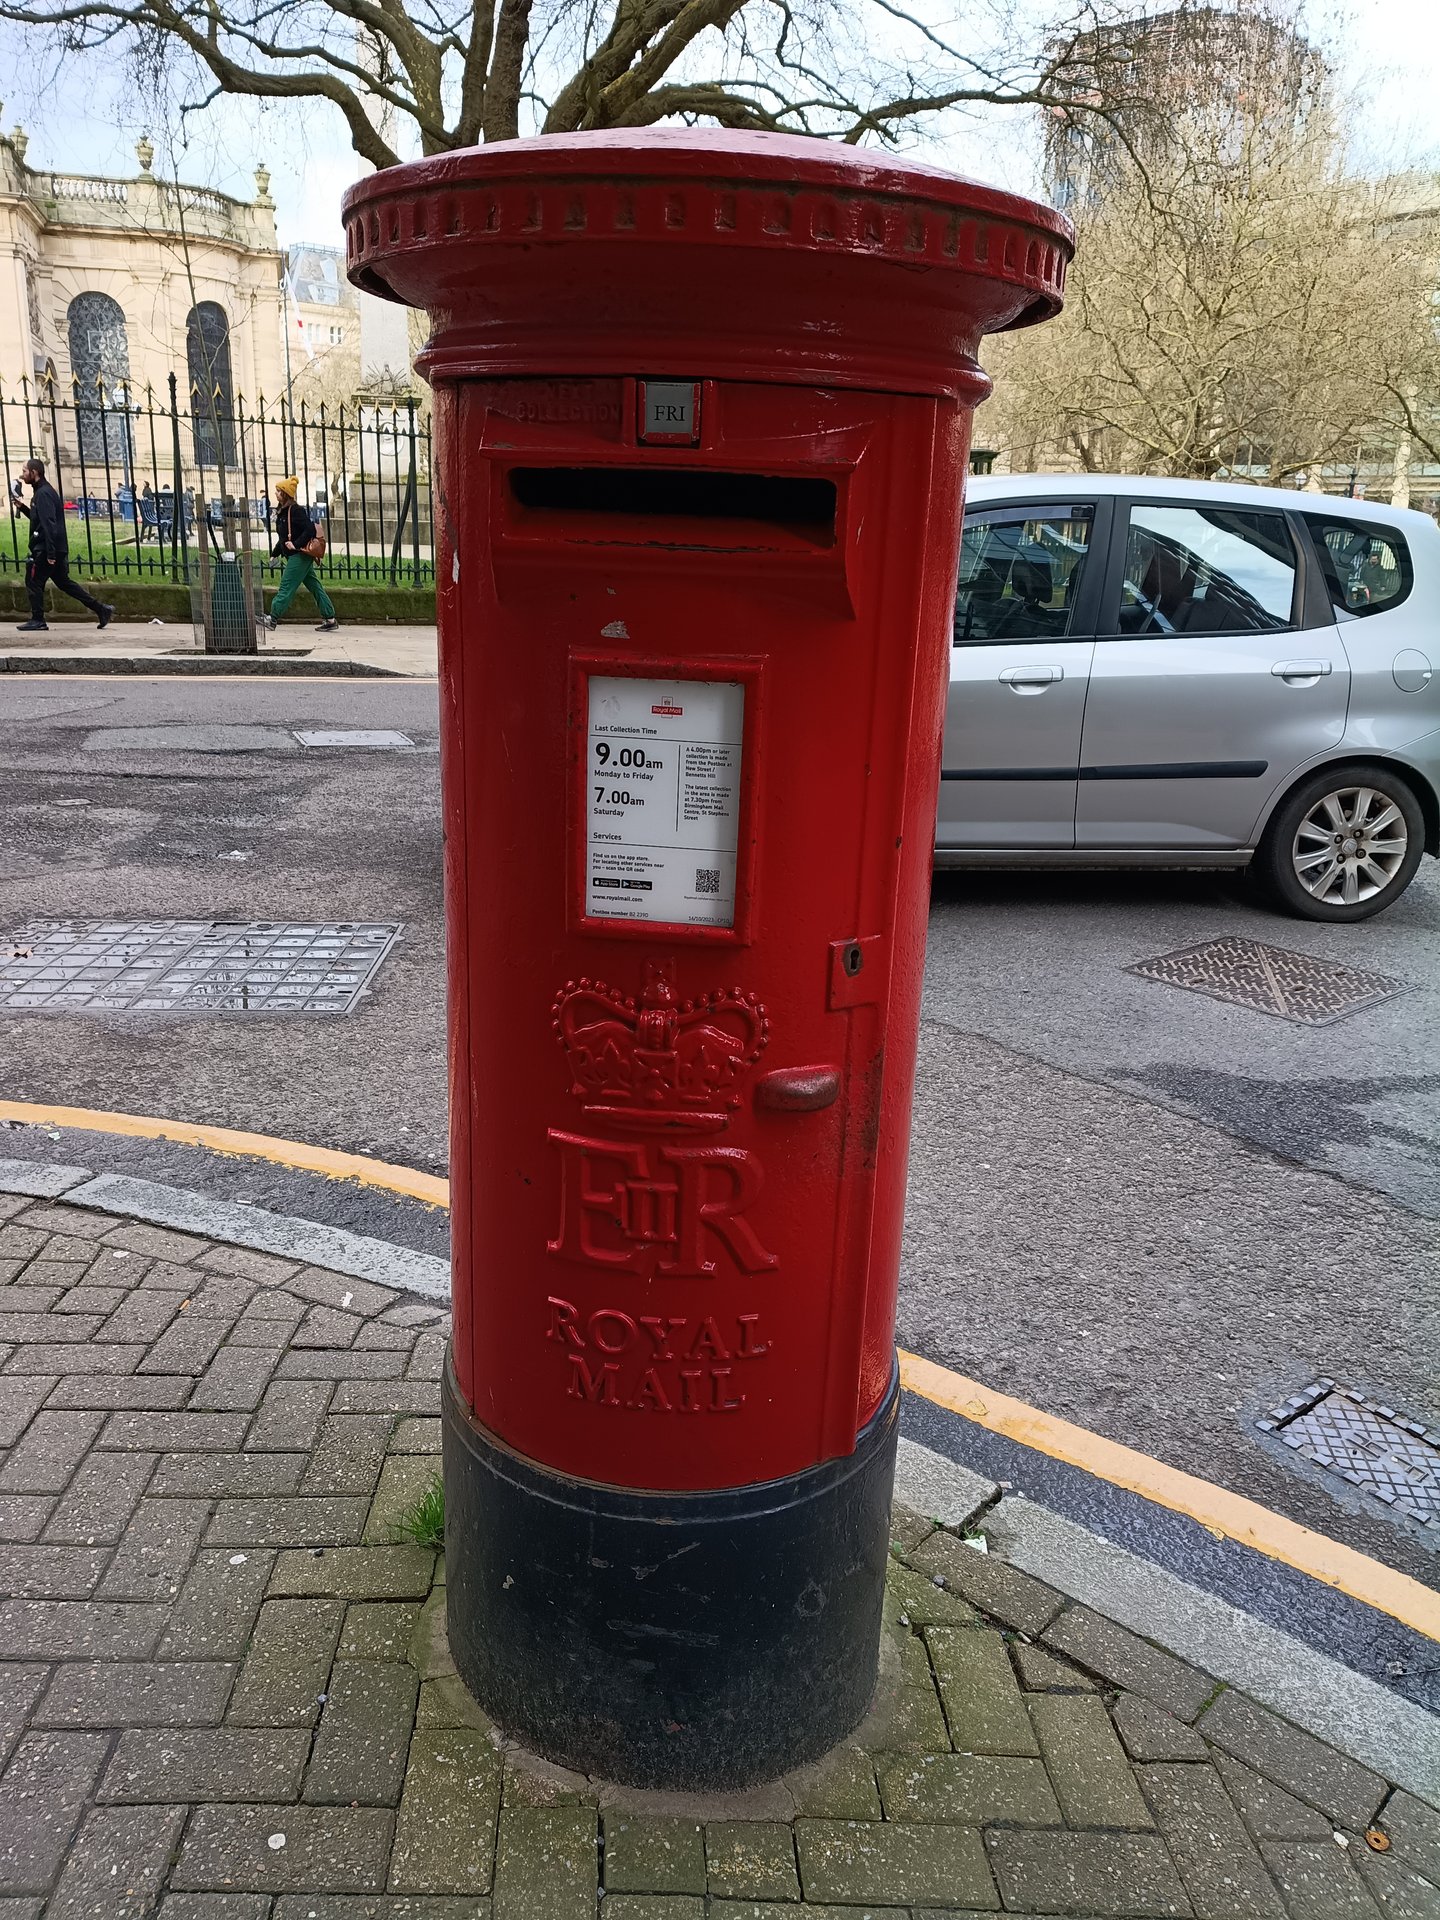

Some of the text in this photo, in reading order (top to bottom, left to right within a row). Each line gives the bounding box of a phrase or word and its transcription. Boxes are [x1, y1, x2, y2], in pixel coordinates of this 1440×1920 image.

[516, 401, 620, 423] COLLECTION
[654, 406, 686, 421] FRI
[610, 725, 640, 733] Collection
[595, 742, 663, 769] 9.00am
[594, 769, 621, 779] Monday
[632, 772, 654, 781] Friday
[594, 787, 645, 806] 7.00am
[593, 808, 624, 817] Saturday
[593, 832, 622, 841] Services
[546, 1296, 773, 1361] ROYAL
[568, 1354, 747, 1412] MAIL
